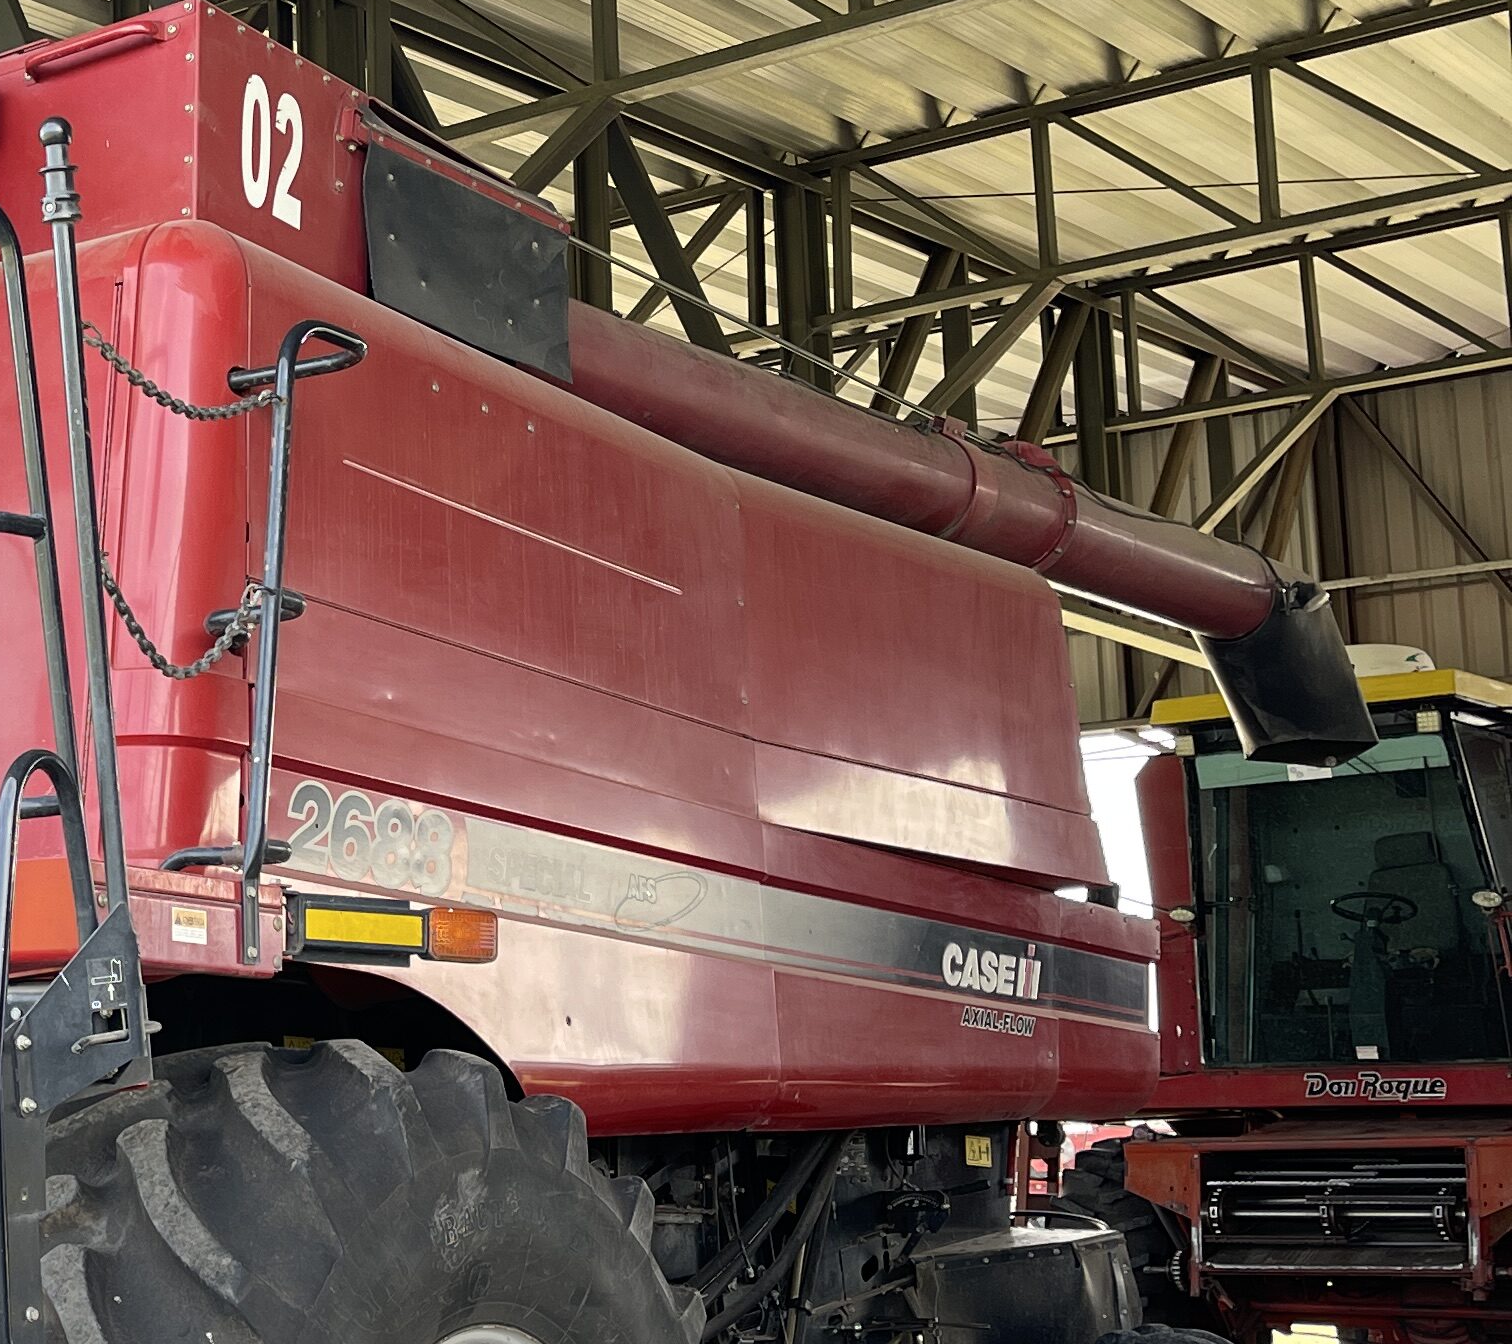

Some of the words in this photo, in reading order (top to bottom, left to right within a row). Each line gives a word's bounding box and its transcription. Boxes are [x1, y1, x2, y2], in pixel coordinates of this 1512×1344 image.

[241, 74, 303, 230] 02
[286, 779, 455, 898] 2688
[627, 873, 658, 905] AFS
[942, 942, 1017, 996] CASE
[960, 1006, 1037, 1038] AXIAL-FLOW
[1304, 1072, 1359, 1098] Don
[1358, 1071, 1448, 1102] Roque
